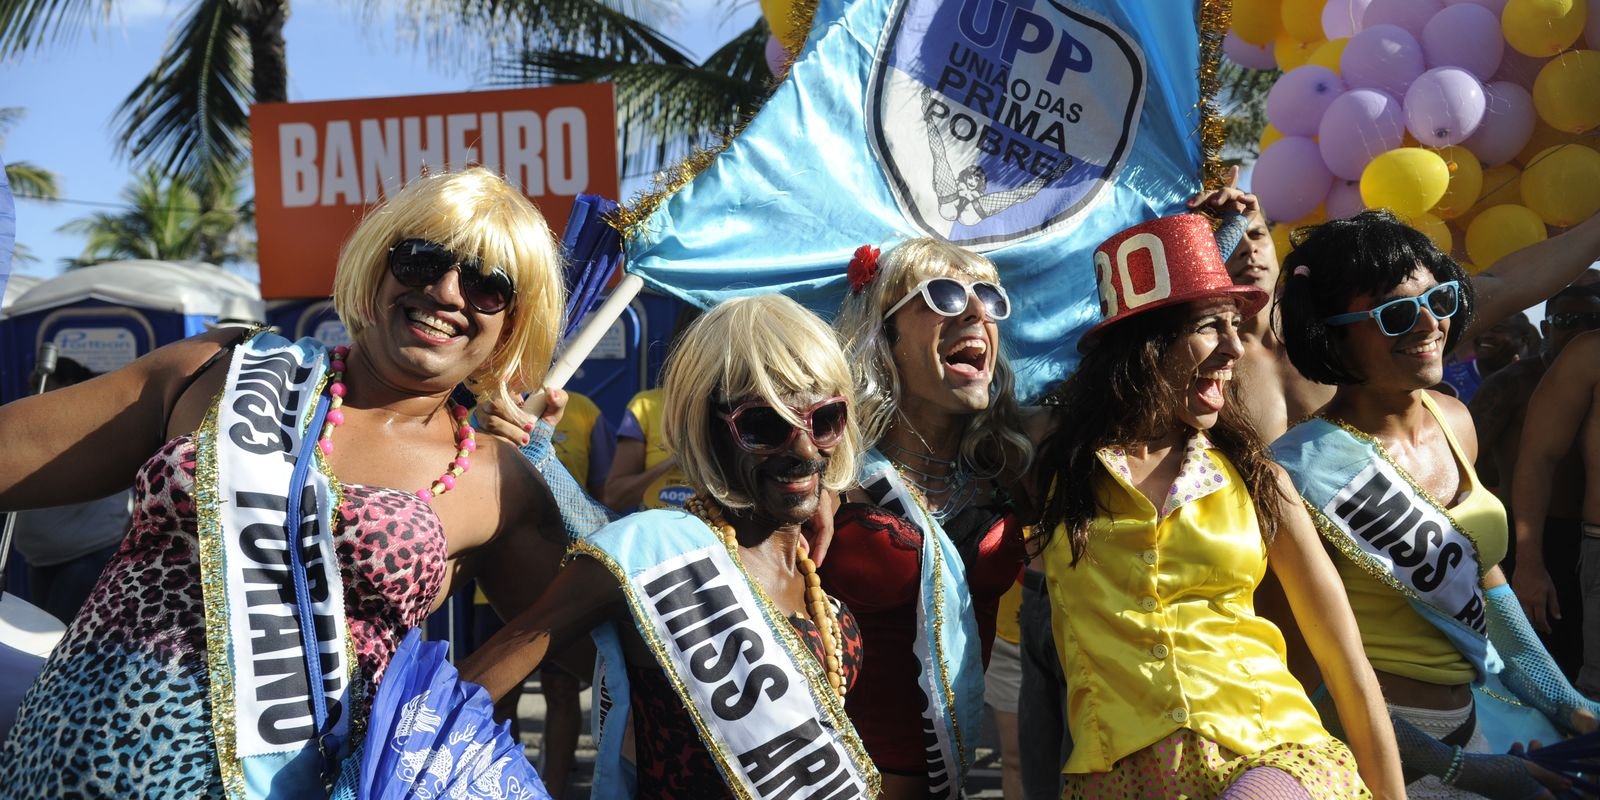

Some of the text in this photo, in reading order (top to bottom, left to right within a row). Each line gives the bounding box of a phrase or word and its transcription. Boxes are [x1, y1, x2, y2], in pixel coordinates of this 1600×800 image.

[949, 41, 1083, 124] UNIÃO DAS
[958, 0, 1093, 86] UPP
[924, 98, 1058, 179] POBRE
[935, 65, 1066, 153] PRIMA
[279, 107, 589, 207] BANHEIRO
[229, 351, 314, 456] MISS
[1334, 471, 1463, 592] MISS
[643, 556, 789, 721] MISS
